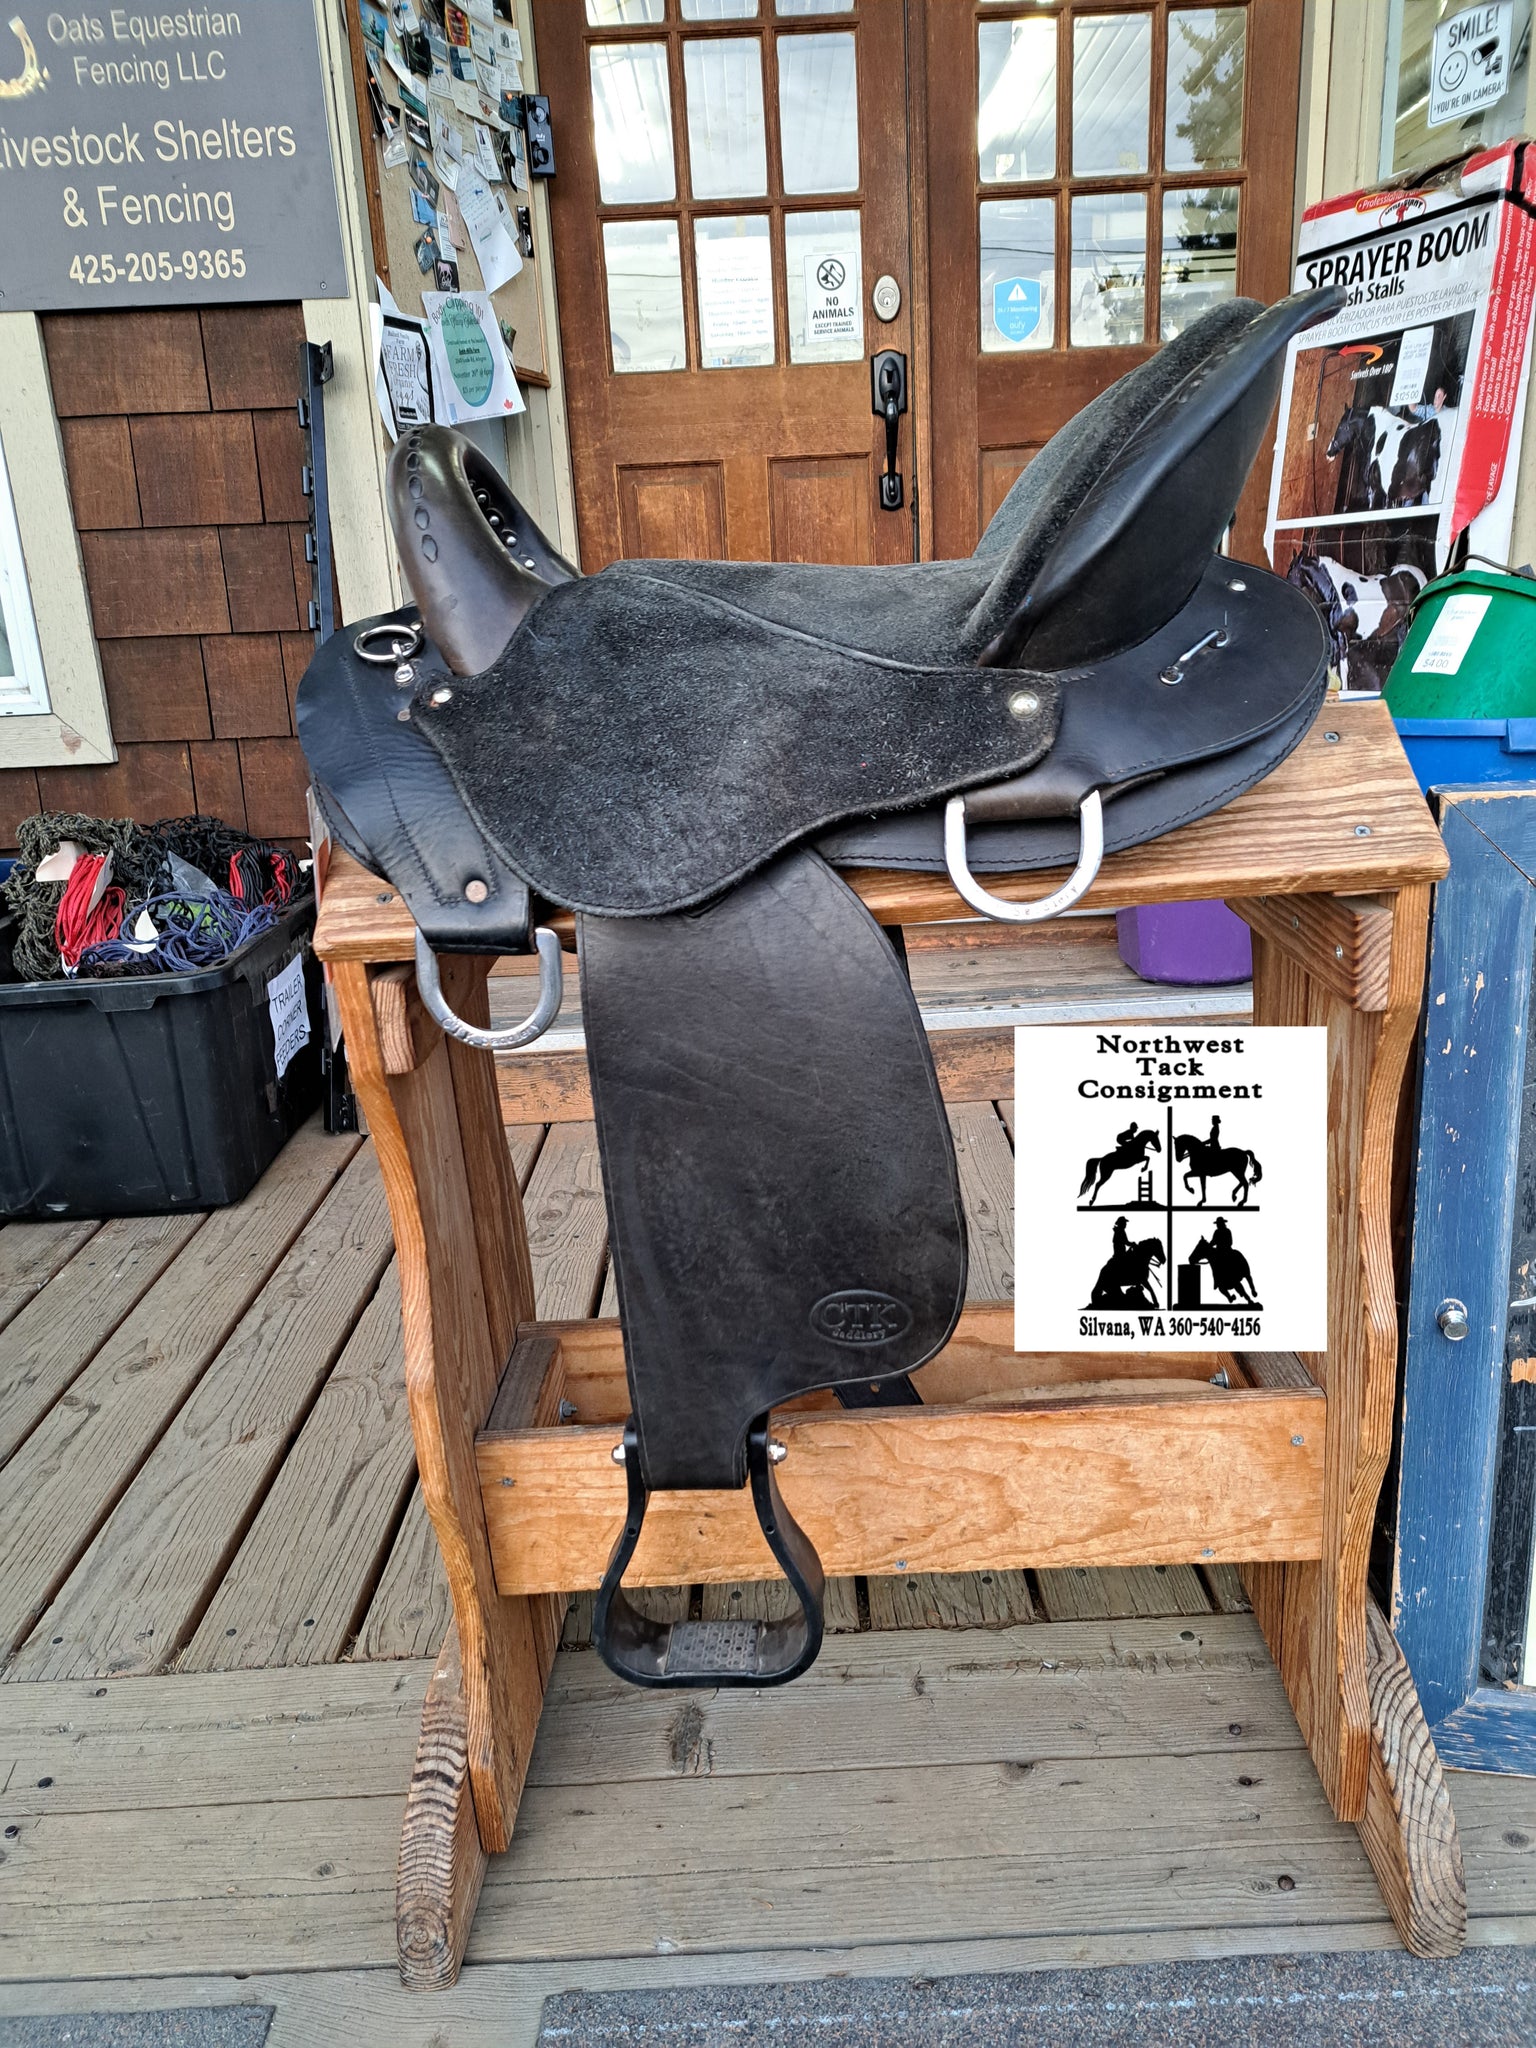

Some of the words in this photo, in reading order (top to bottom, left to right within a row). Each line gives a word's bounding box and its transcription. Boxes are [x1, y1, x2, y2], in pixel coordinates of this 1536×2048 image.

[47, 12, 105, 44] Oats
[110, 7, 242, 46] Equestrian
[1448, 5, 1500, 48] SMILE!
[73, 54, 170, 89] Fencing
[176, 51, 227, 80] LLC
[1462, 92, 1471, 105] ON
[1472, 83, 1501, 101] CAMERA
[0, 122, 145, 168] ivestock
[153, 118, 297, 161] Shelters
[63, 186, 88, 228] &
[97, 183, 235, 231] Fencing
[69, 249, 247, 284] 425-205-9365
[1306, 238, 1412, 289] SPRAYER
[1416, 211, 1490, 268] BOOM
[825, 296, 839, 307] NO
[1347, 285, 1364, 307] sh
[1366, 276, 1405, 303] Stalls
[812, 306, 855, 320] ANIMALS
[1487, 461, 1498, 490] LAVAGE
[271, 974, 303, 1014] TRAILER
[277, 999, 303, 1041] CORNER
[276, 1024, 306, 1069] FEEDERS
